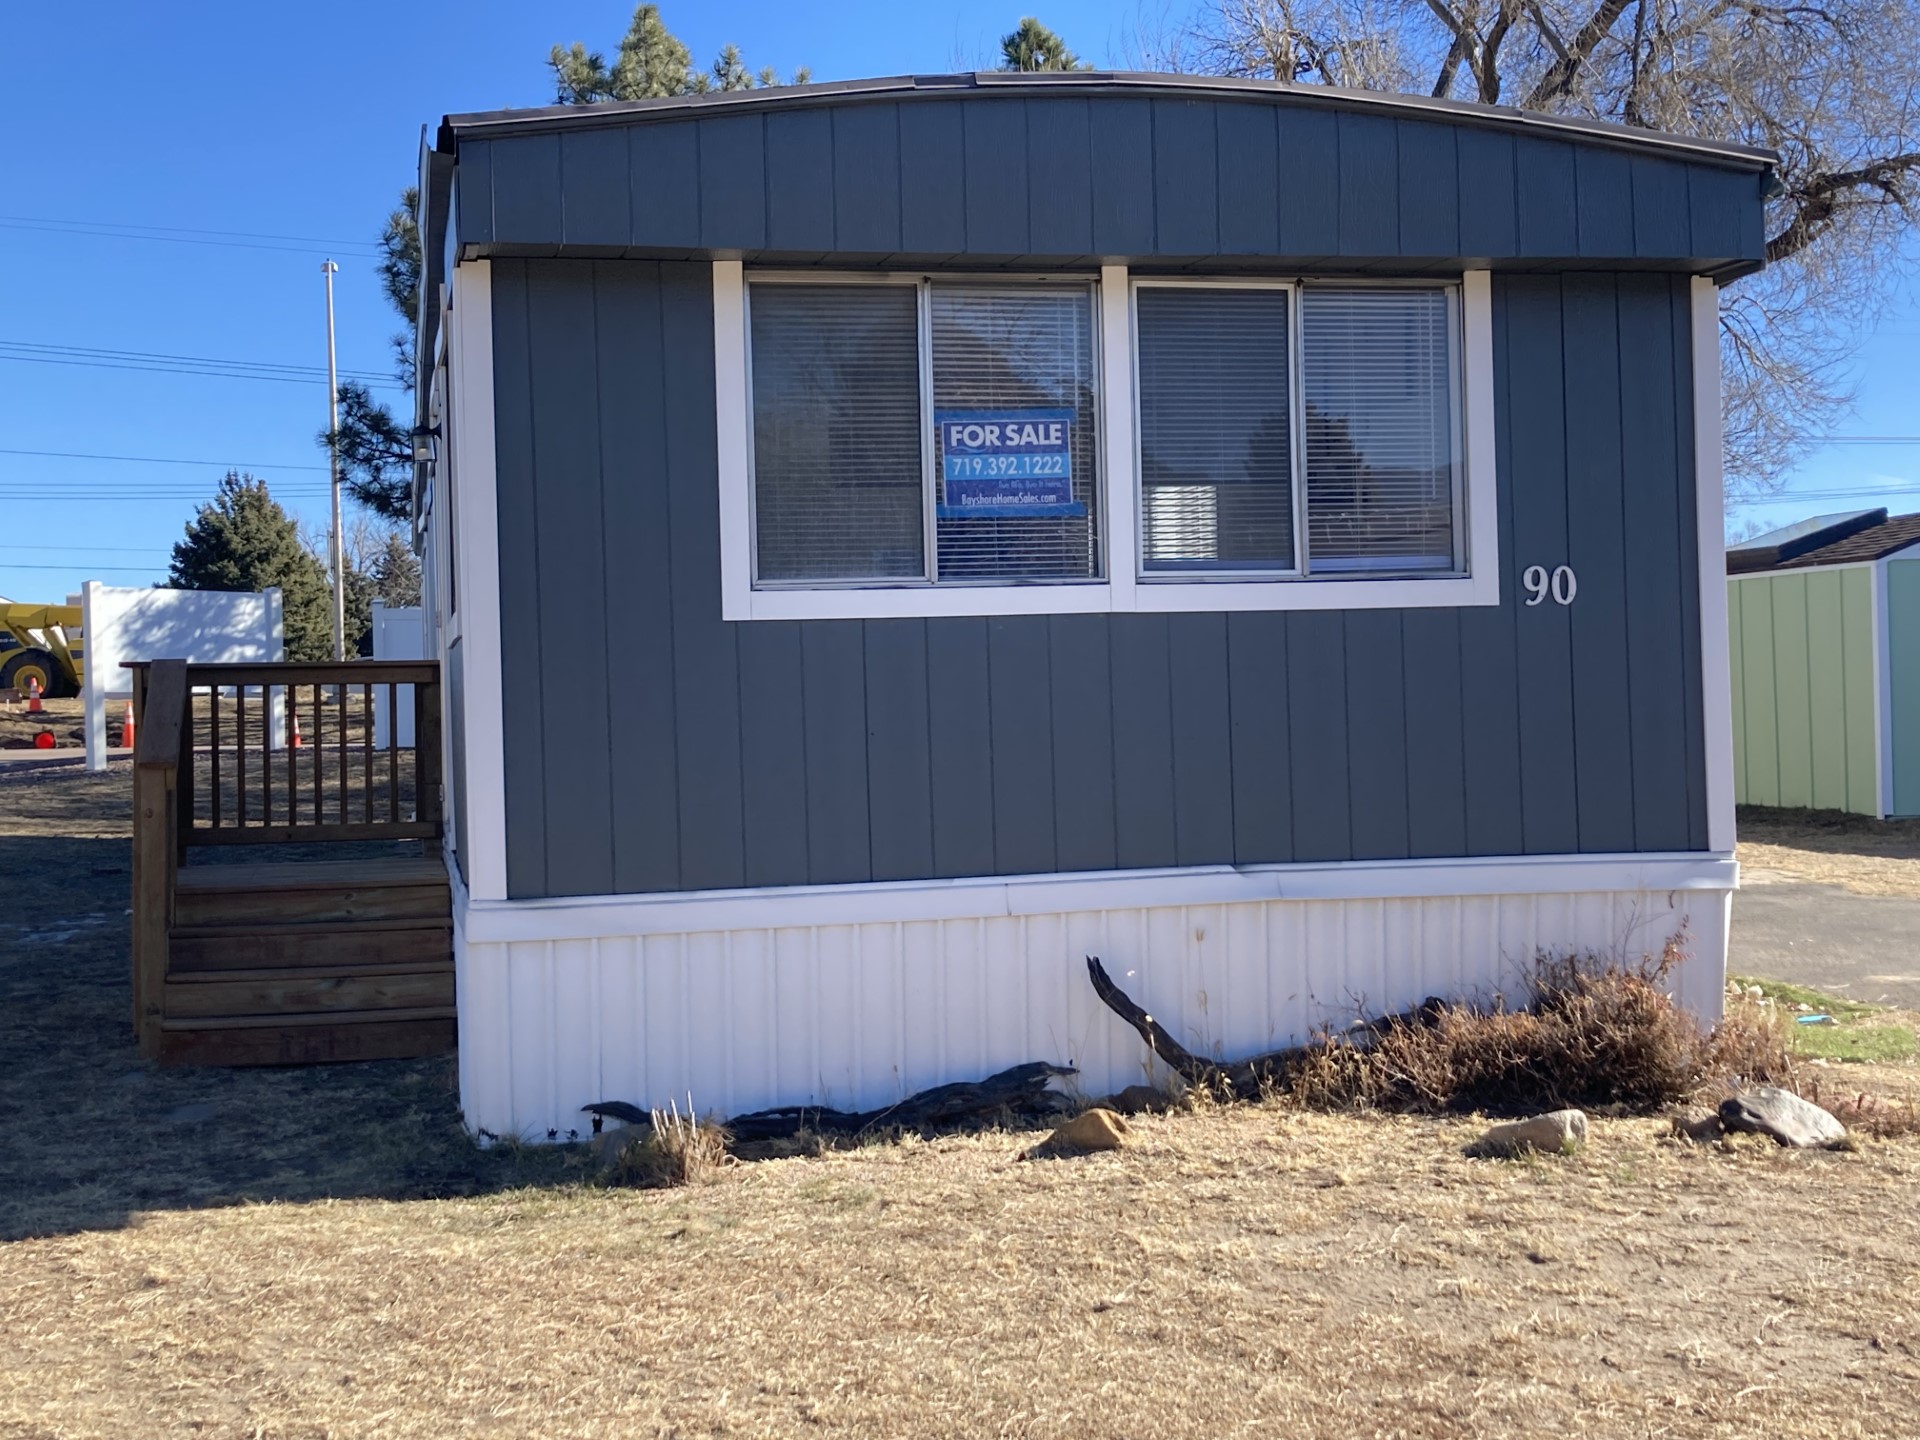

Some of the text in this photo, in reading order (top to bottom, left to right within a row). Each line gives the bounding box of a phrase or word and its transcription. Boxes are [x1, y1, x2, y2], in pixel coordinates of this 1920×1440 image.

[950, 423, 1062, 447] FOR SALE
[952, 456, 1063, 476] 719.392.1222
[961, 492, 1057, 505] BayshoreHomeSales.com
[1523, 565, 1577, 606] 90
